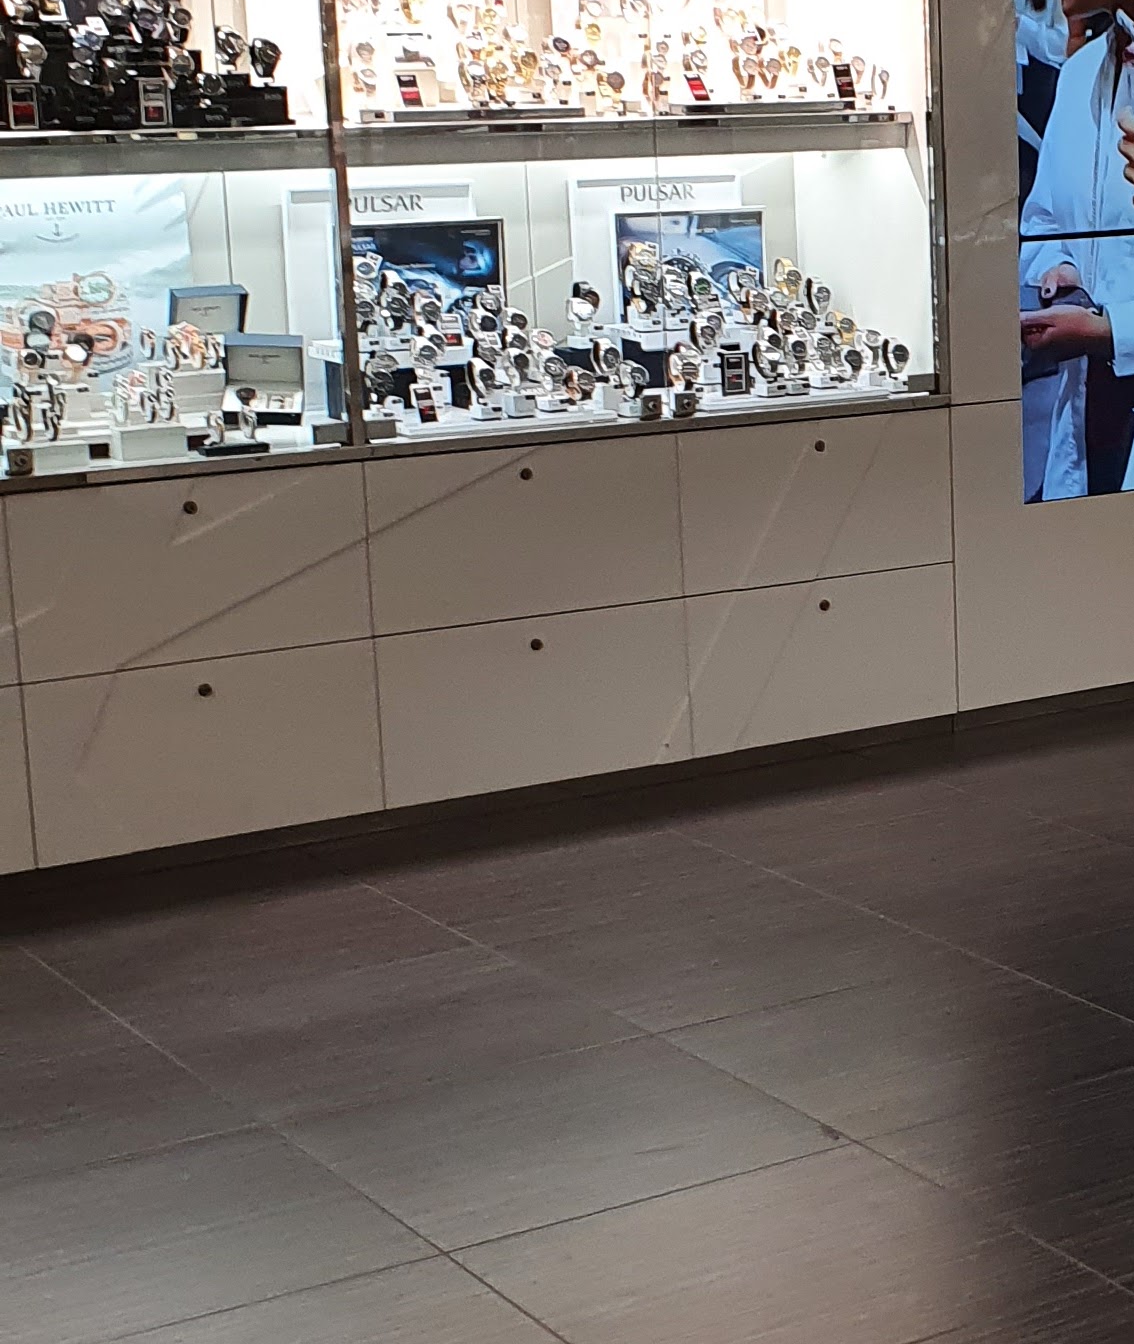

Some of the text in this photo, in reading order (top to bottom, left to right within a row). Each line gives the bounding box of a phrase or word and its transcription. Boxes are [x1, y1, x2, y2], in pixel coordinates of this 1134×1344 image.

[620, 183, 696, 203] PULSAR
[0, 199, 116, 218] AUL HEWITT
[348, 193, 424, 214] ULSAR
